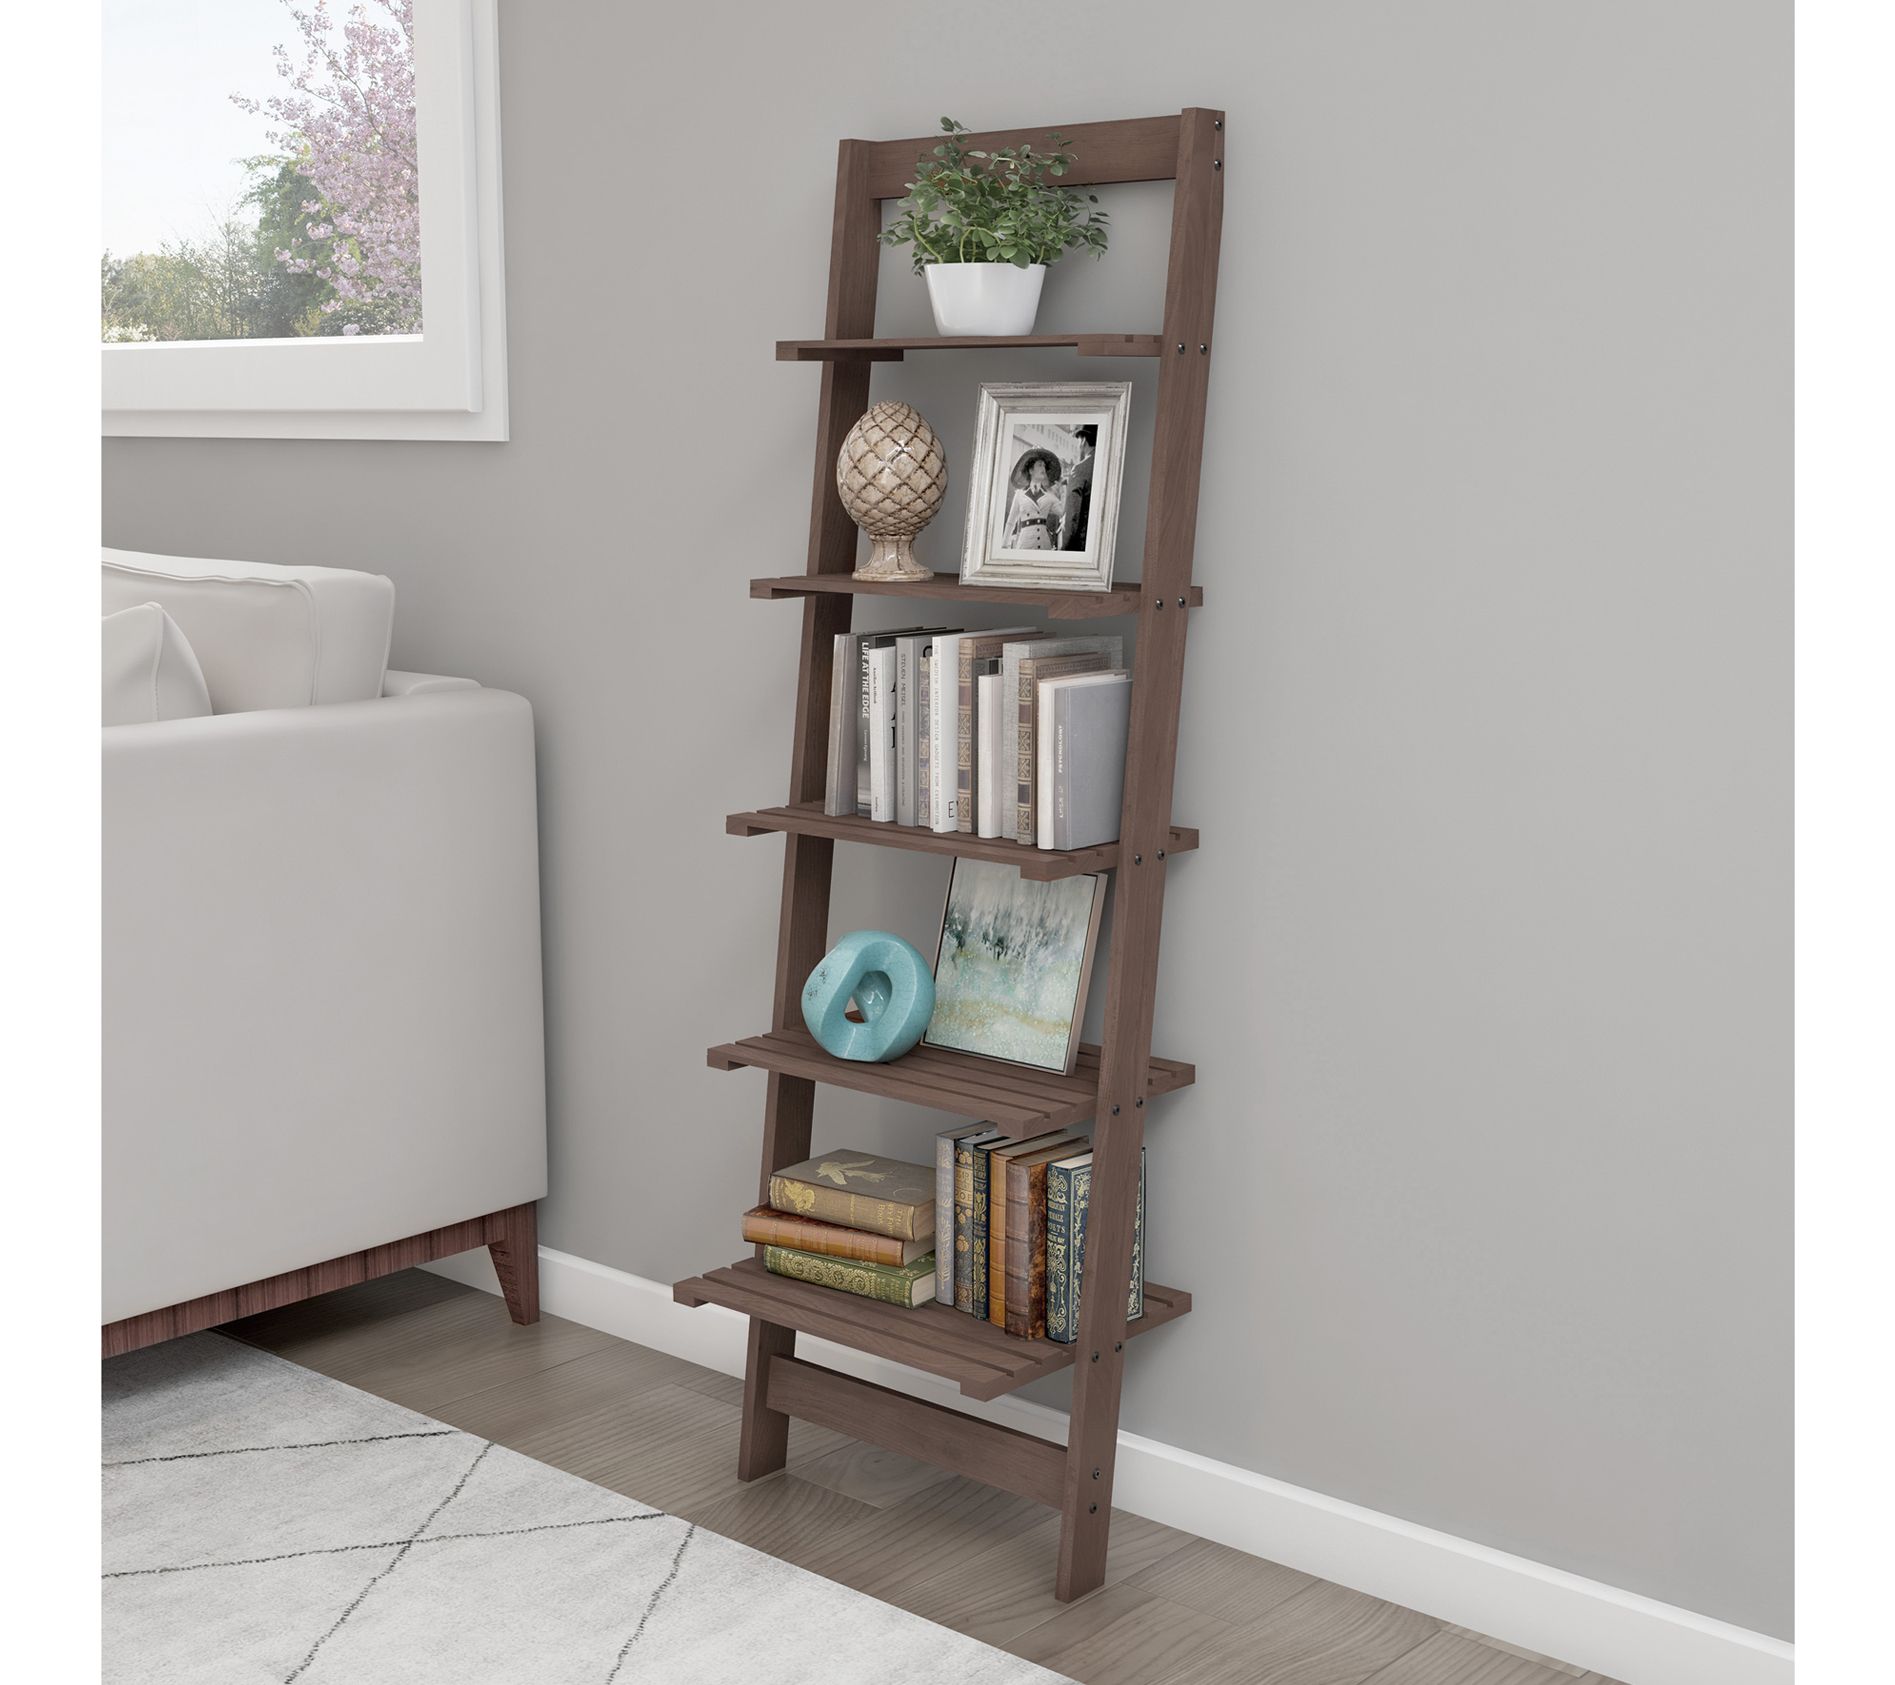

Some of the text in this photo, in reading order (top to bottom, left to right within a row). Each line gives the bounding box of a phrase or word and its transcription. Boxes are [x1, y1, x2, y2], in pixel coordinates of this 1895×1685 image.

[861, 642, 870, 661] LIFE
[861, 662, 870, 674] AT
[862, 675, 870, 694] THE
[862, 694, 871, 720] EDGE
